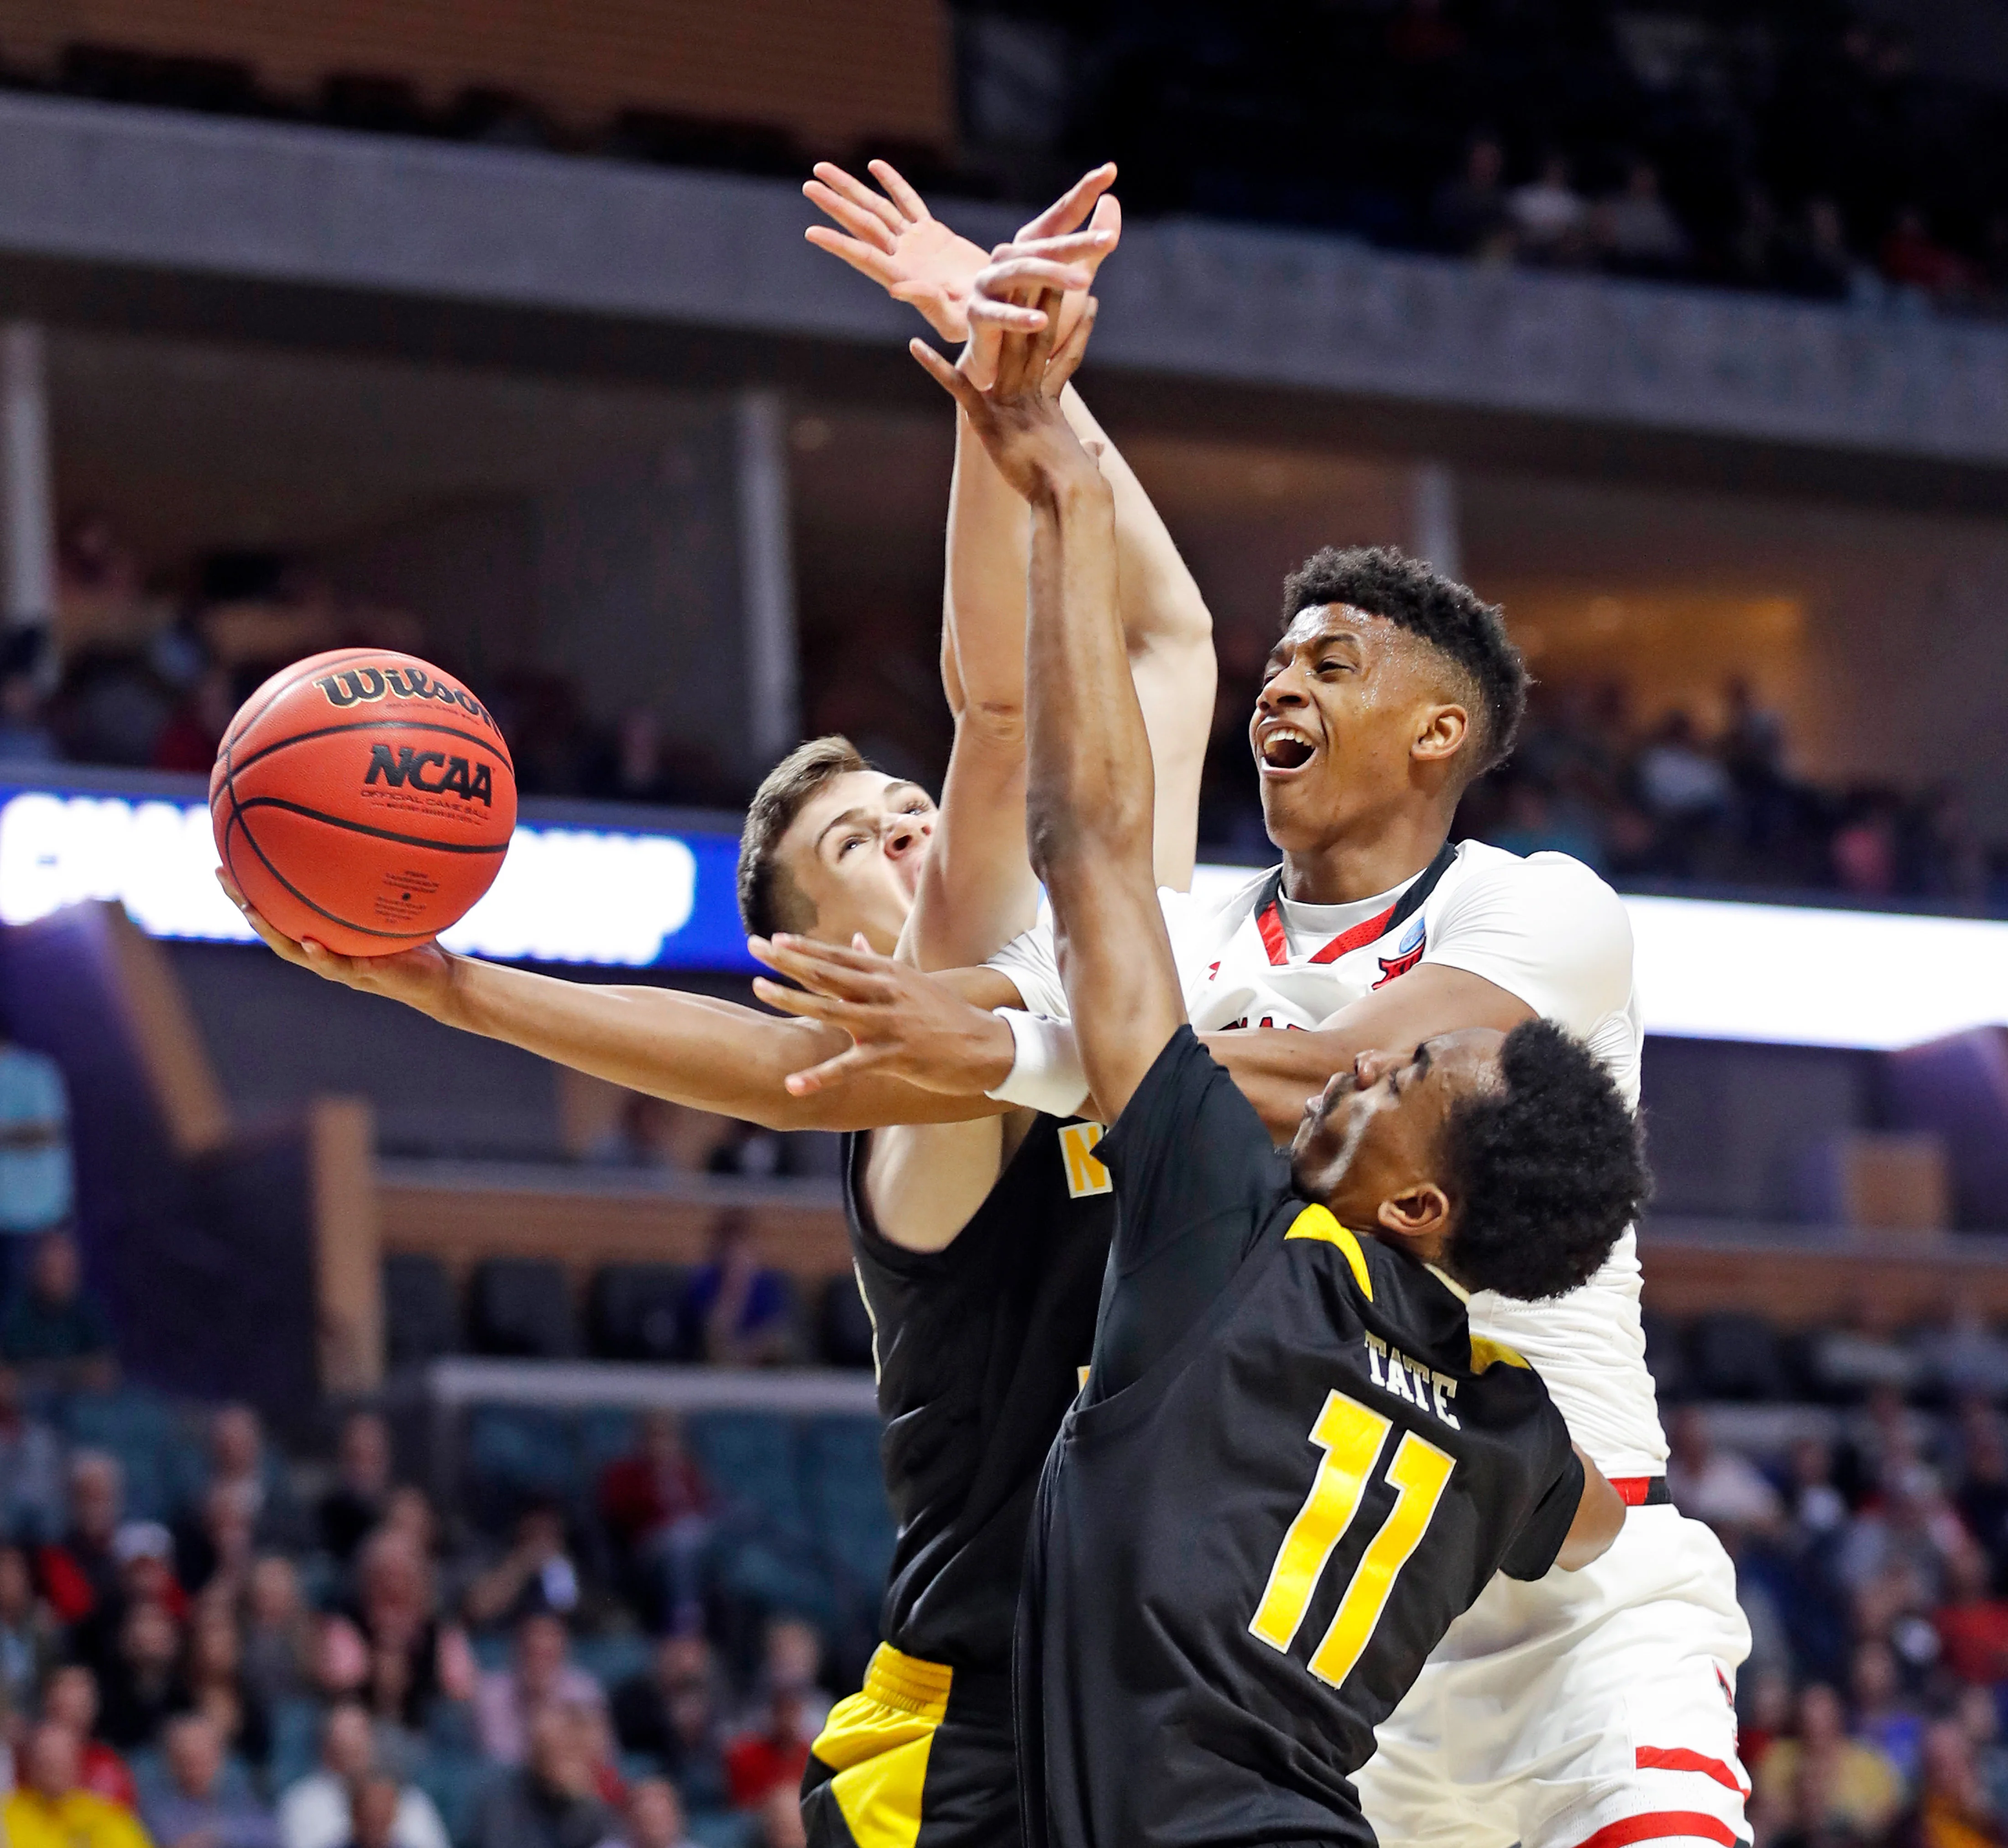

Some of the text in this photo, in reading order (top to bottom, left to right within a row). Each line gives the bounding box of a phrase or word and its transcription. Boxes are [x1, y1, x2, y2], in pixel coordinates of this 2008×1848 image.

[312, 666, 502, 740] Wilson
[365, 744, 492, 807] NCAA
[1364, 1329, 1461, 1430] TATE
[1248, 1388, 1457, 1690] 11
